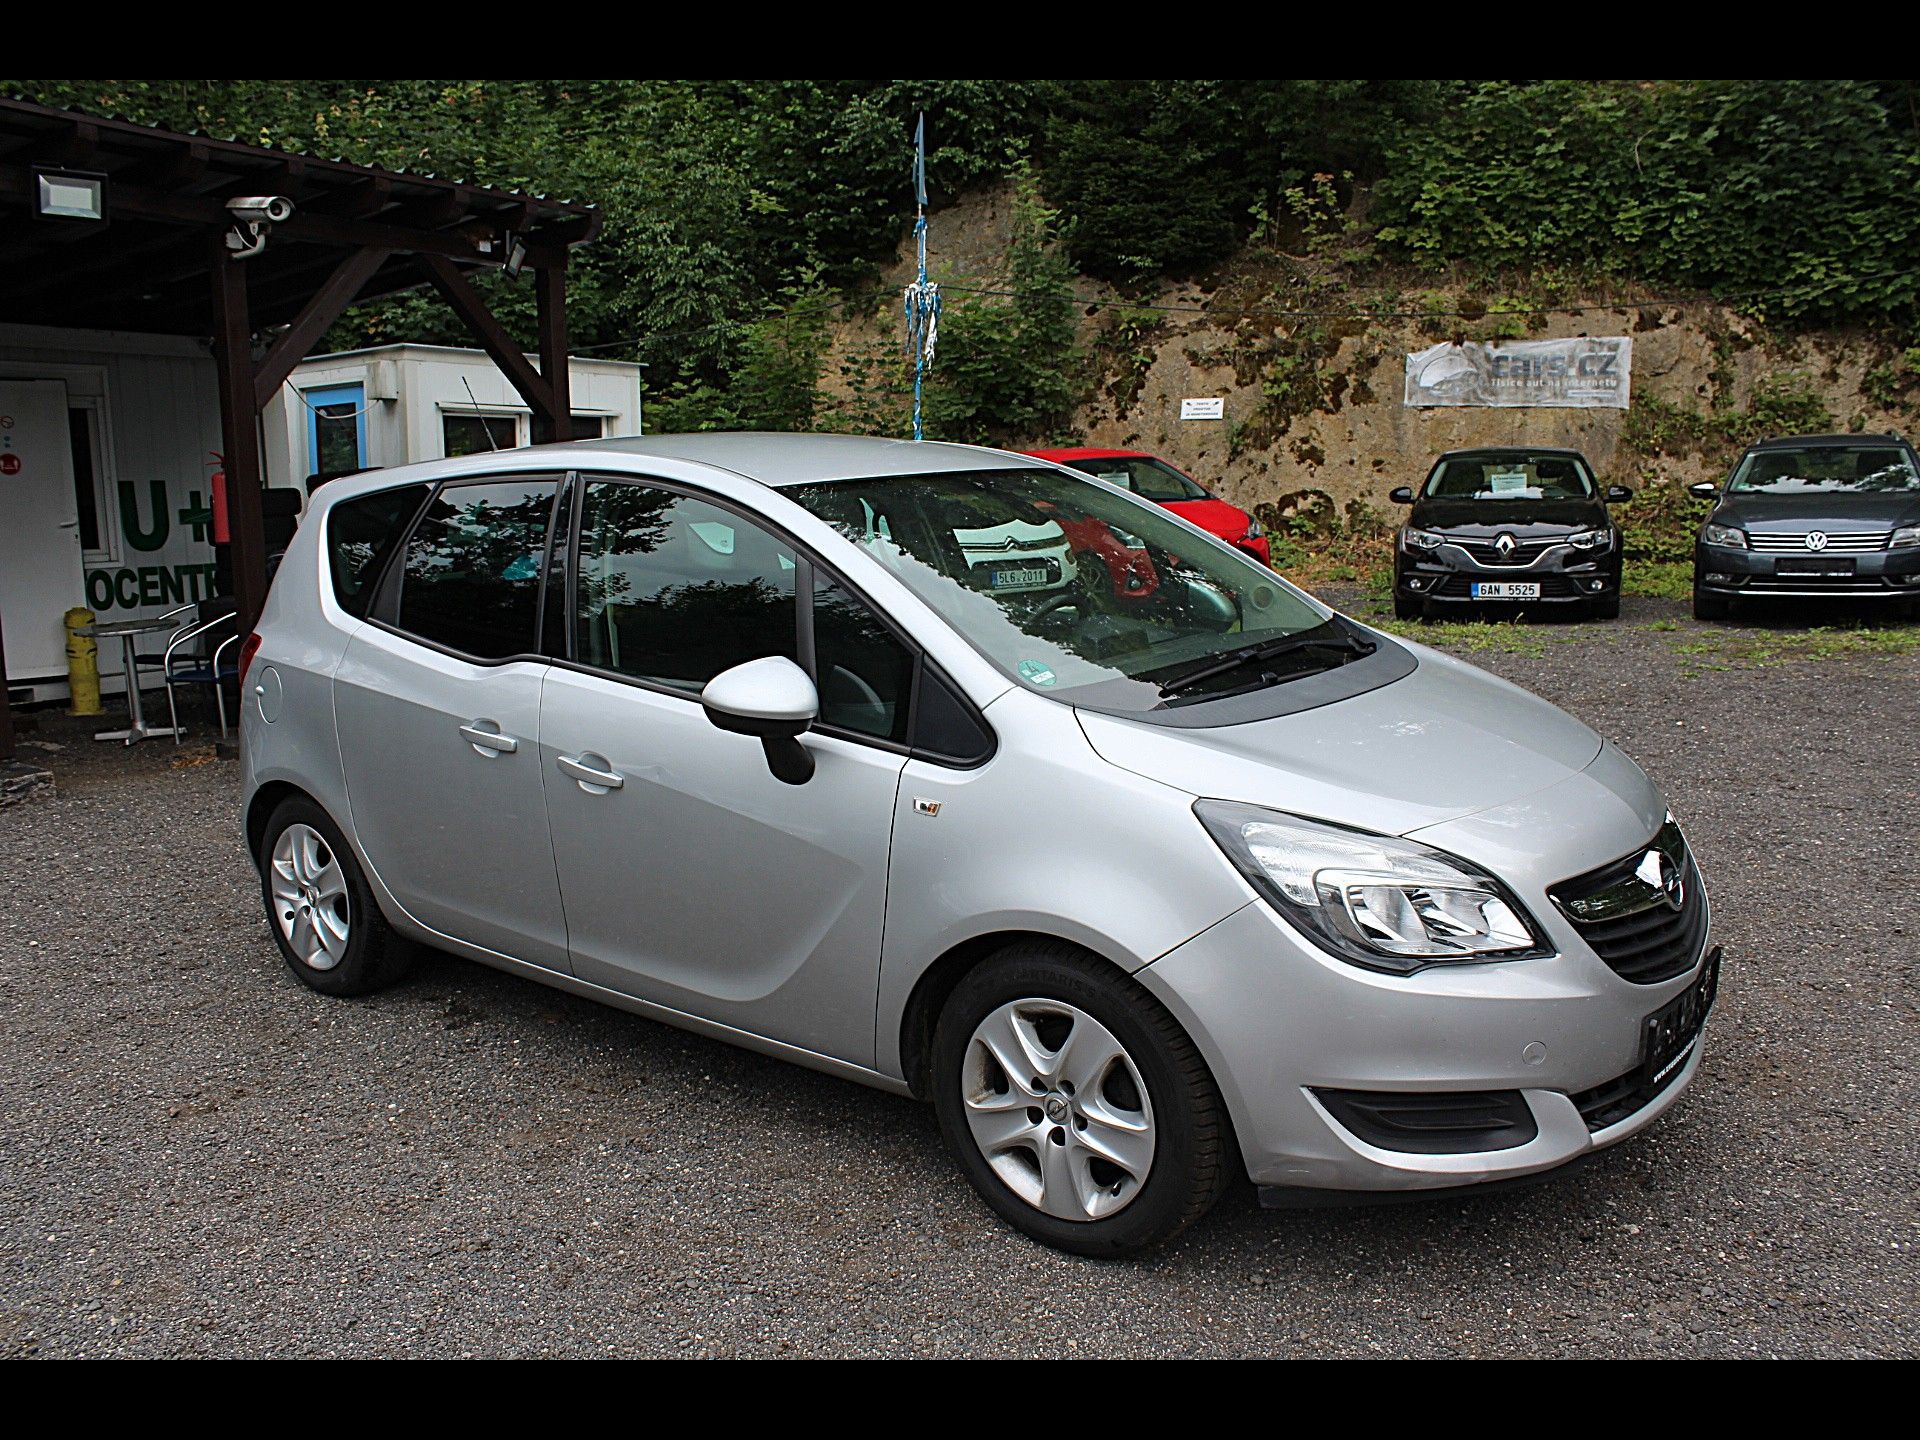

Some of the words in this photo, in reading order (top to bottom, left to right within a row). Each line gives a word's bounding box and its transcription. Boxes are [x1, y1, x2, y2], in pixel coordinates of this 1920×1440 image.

[1021, 570, 1043, 582] 2011
[1480, 584, 1500, 595] 6AN
[1508, 584, 1535, 595] 5525
